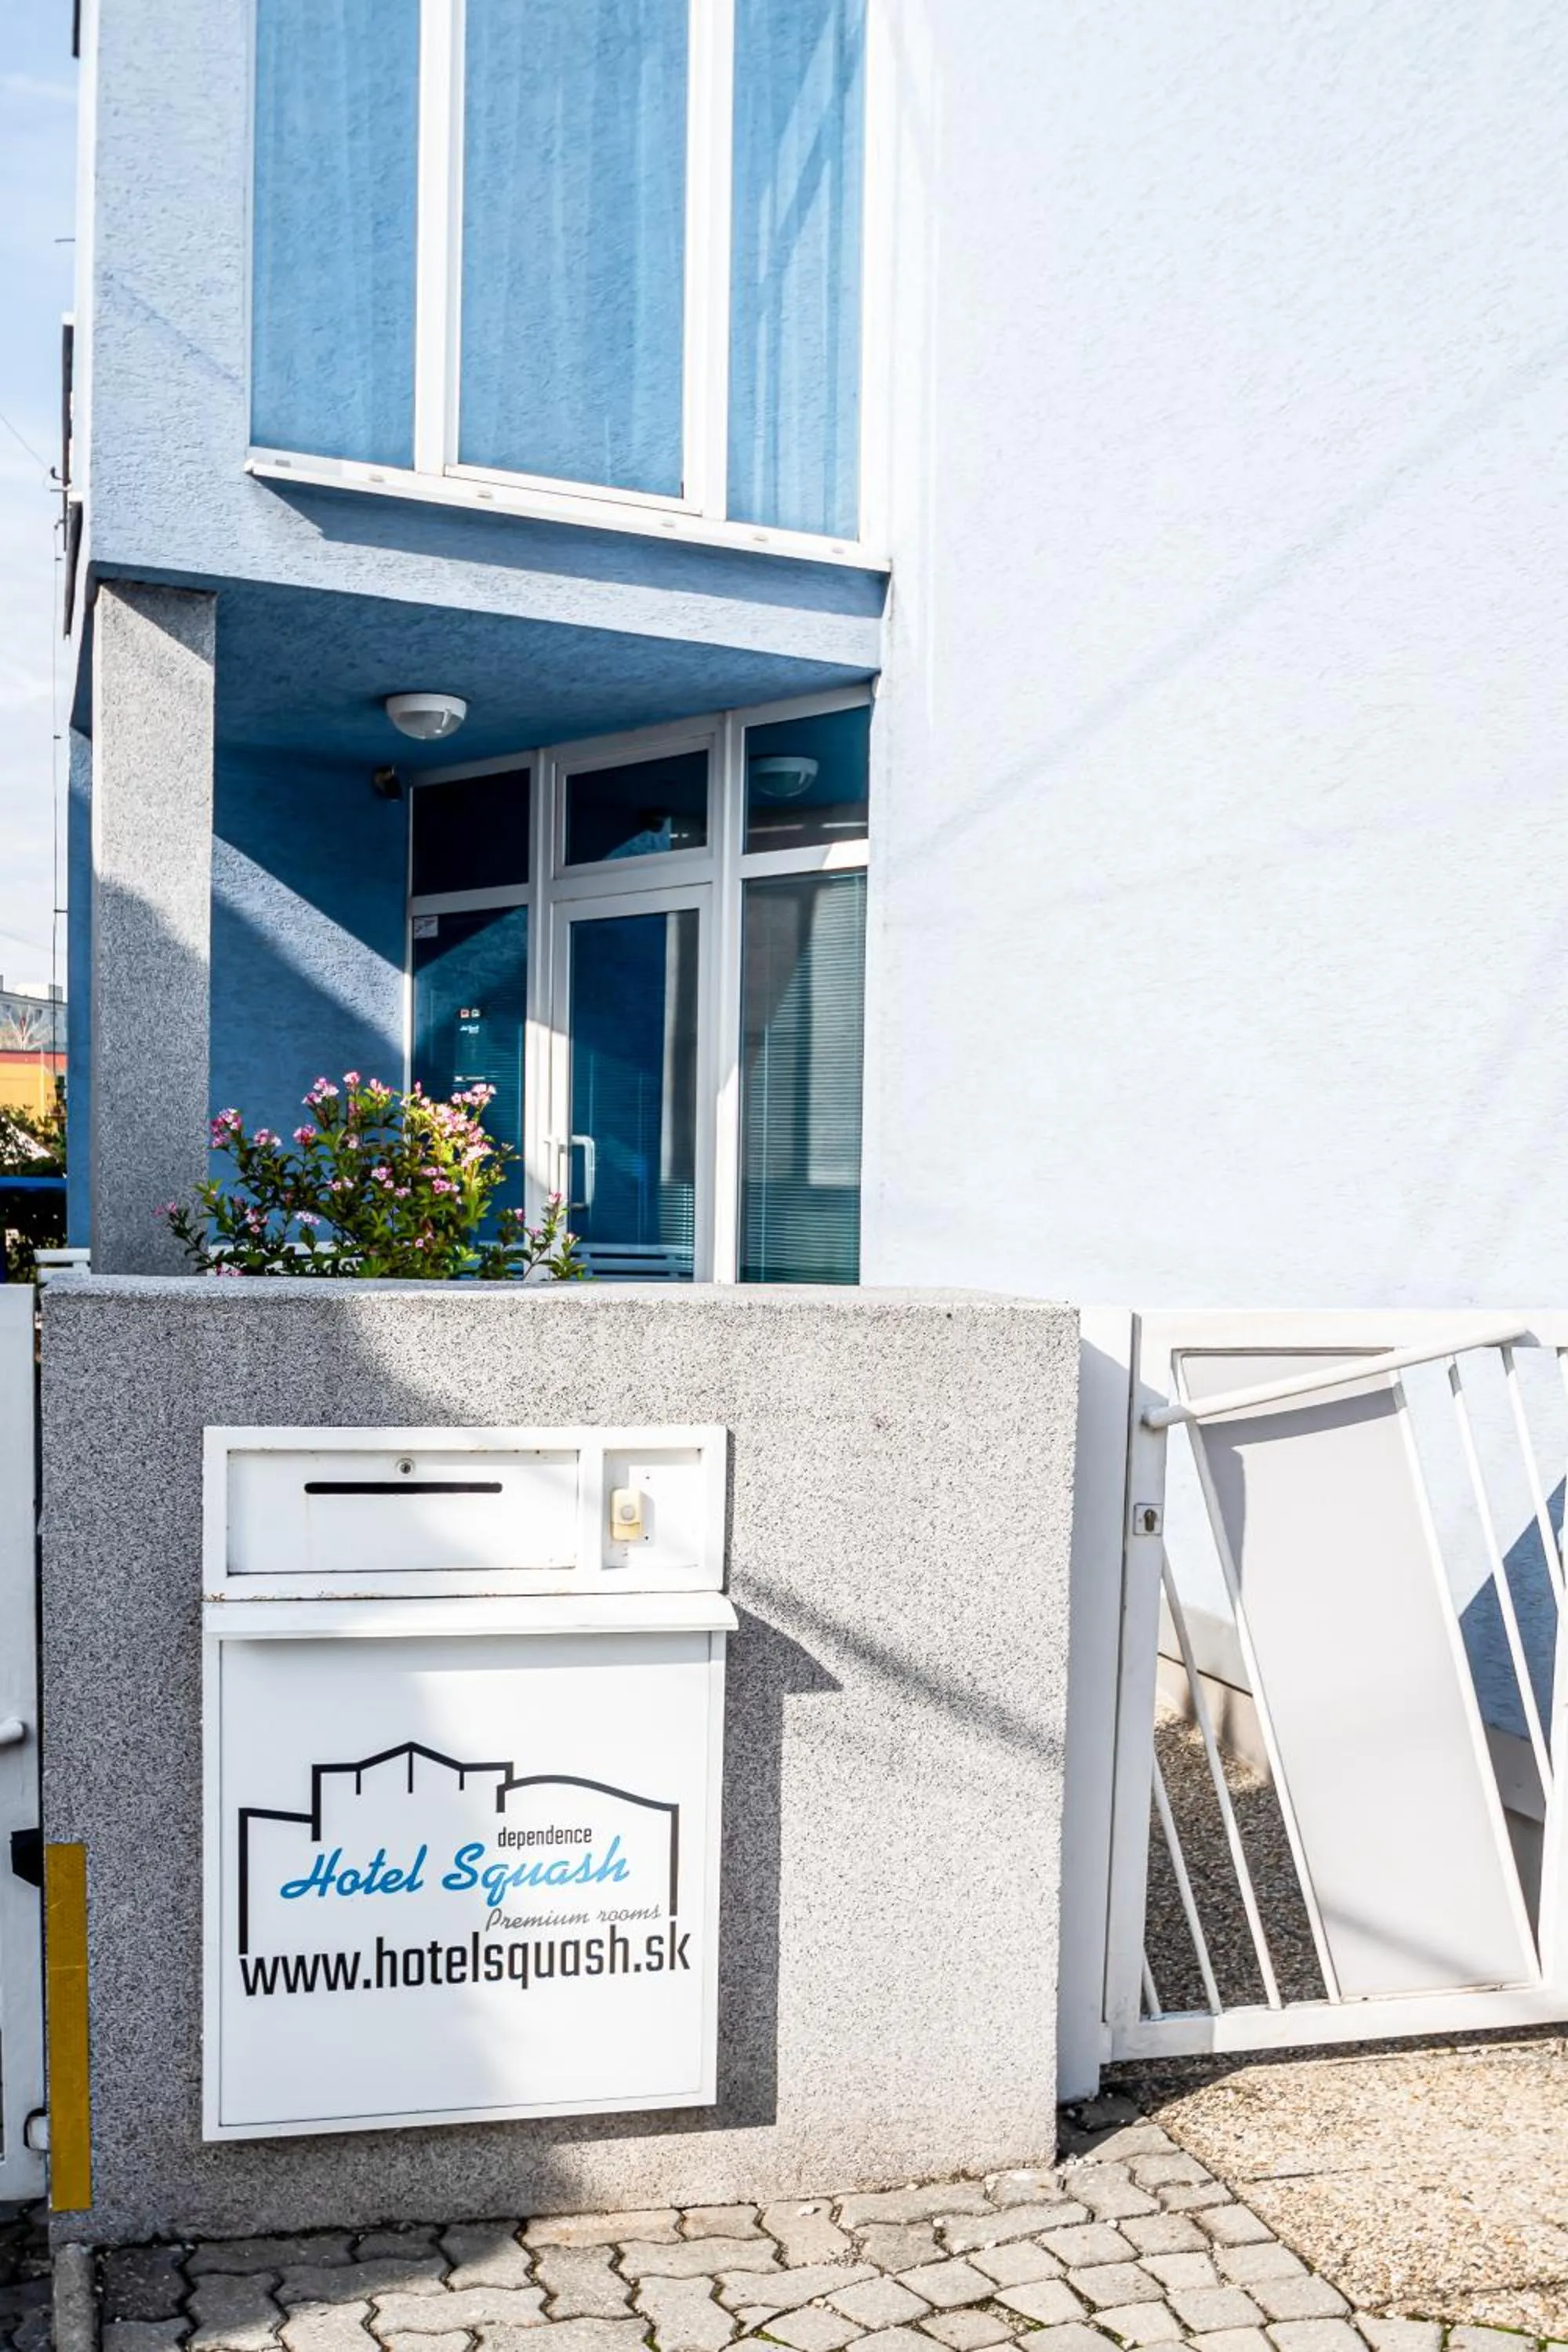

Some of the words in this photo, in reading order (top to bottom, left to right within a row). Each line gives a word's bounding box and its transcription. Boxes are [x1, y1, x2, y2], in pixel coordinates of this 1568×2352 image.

[497, 1825, 593, 1849] dependence
[280, 1844, 427, 1899] Hotel
[441, 1835, 630, 1907] Squash
[485, 1907, 590, 1932] Premium
[598, 1904, 662, 1924] rooms
[239, 1921, 691, 1996] www.hotelsquash.sk
